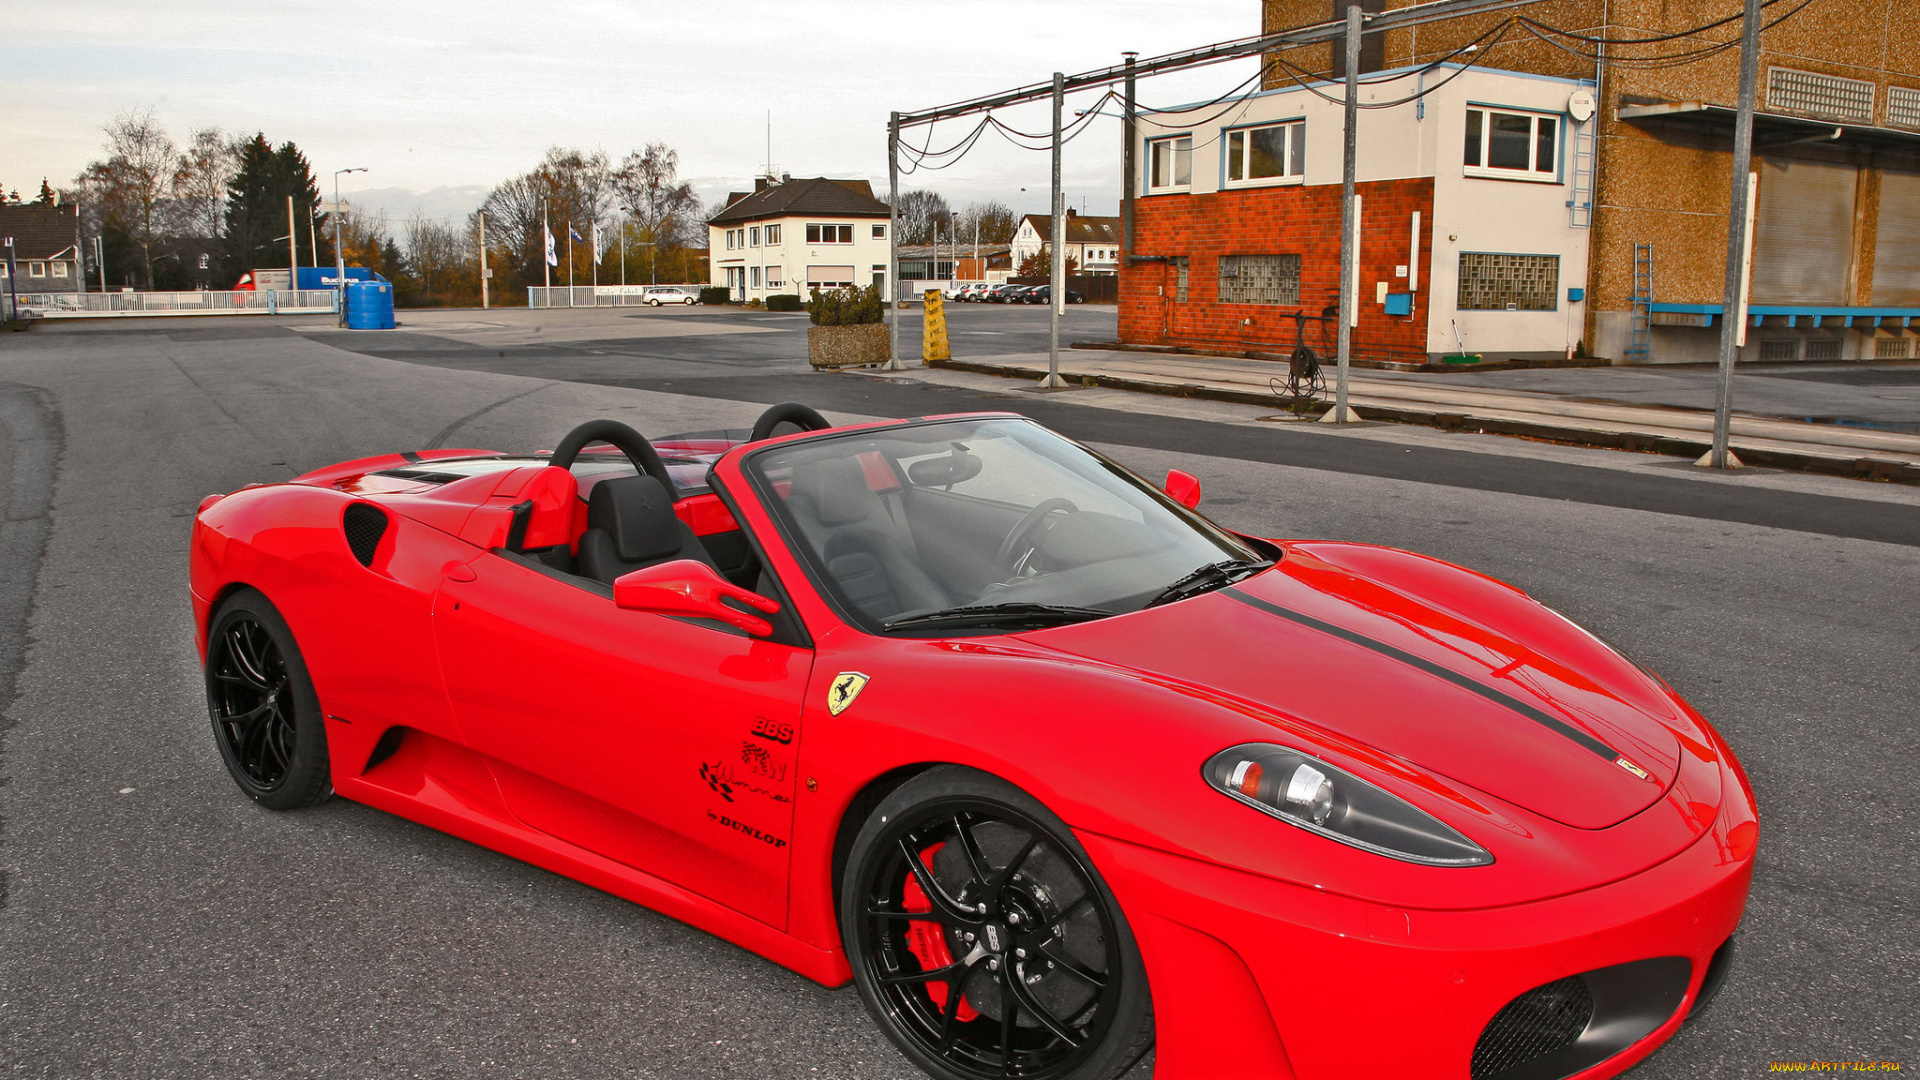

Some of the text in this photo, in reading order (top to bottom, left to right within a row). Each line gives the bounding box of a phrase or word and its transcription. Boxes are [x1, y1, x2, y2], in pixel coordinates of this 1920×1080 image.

[751, 715, 794, 745] BBS
[719, 815, 787, 848] DUNLOP
[986, 924, 1000, 951] BBS
